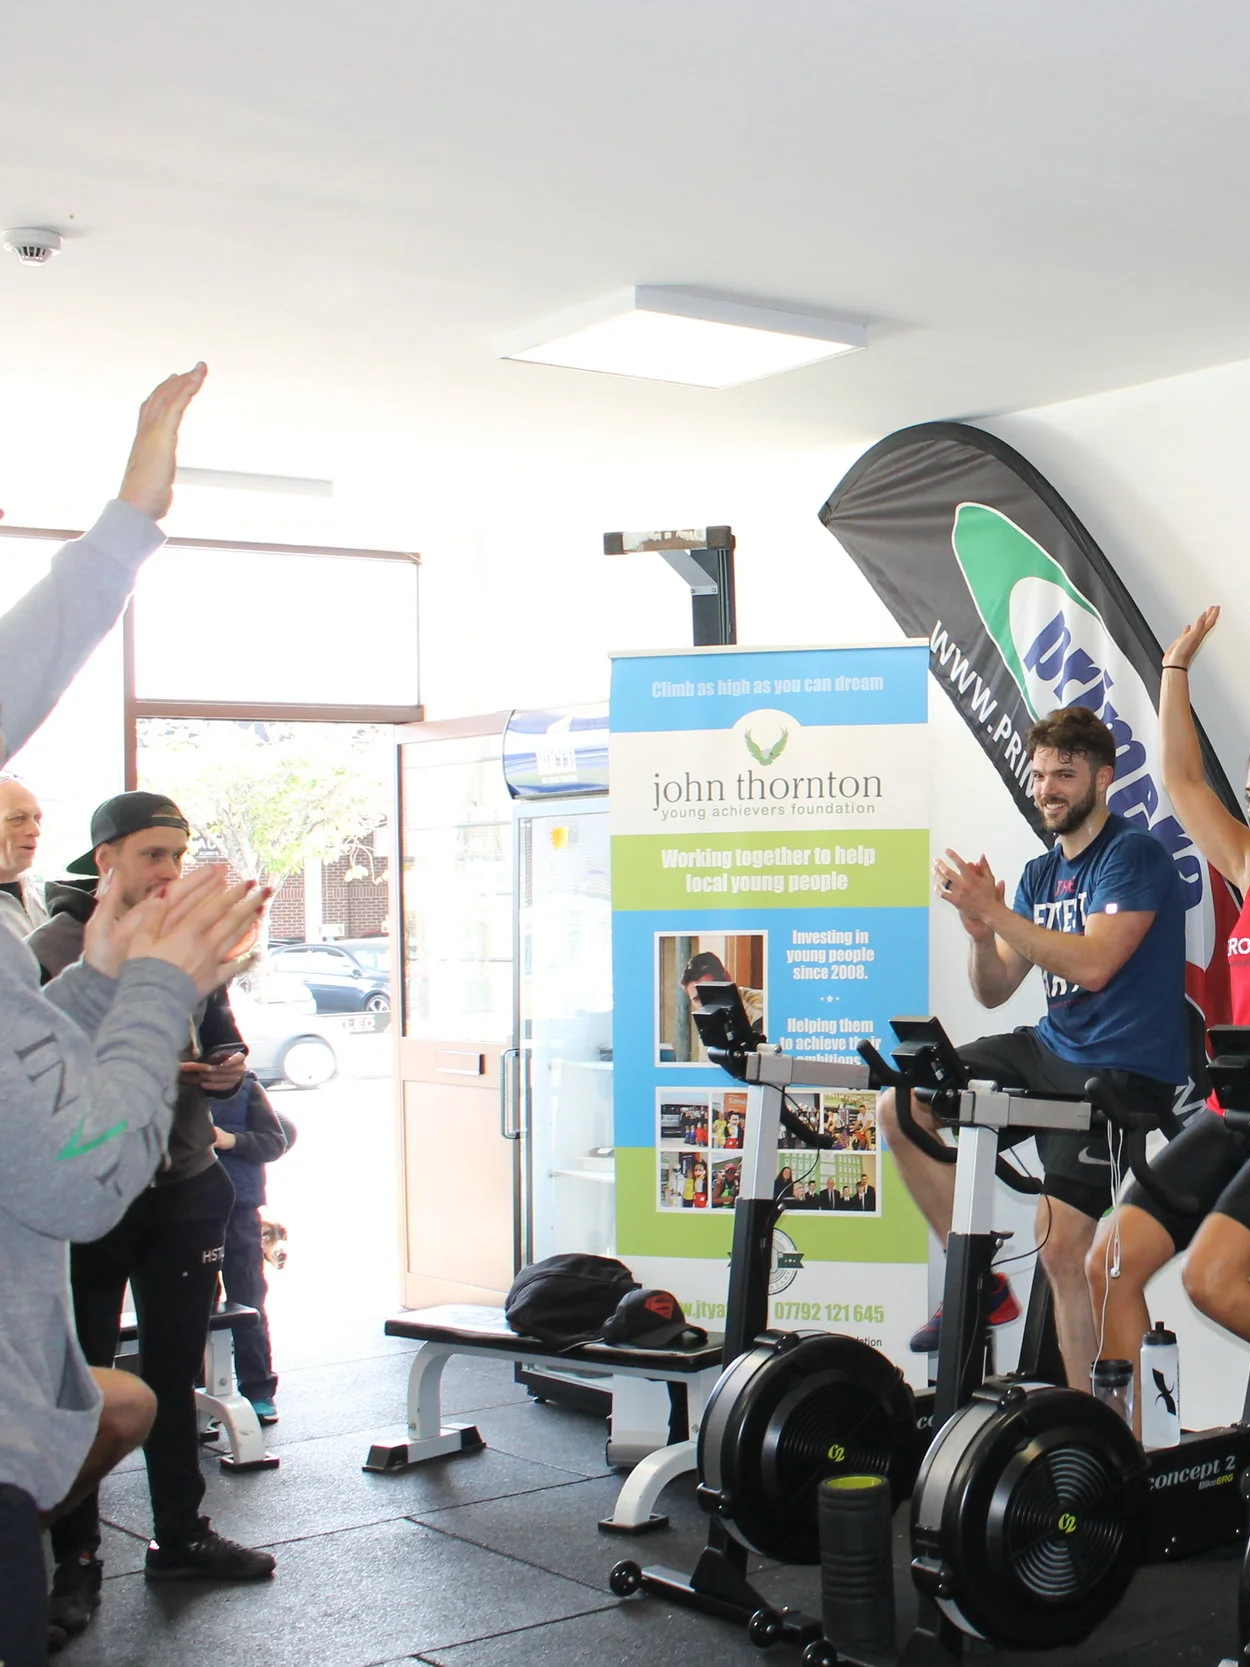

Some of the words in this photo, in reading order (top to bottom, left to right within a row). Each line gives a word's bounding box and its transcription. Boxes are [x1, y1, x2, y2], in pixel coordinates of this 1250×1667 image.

[652, 681, 694, 698] Climb
[697, 683, 714, 696] as
[717, 679, 750, 696] high
[753, 680, 770, 694] as
[774, 680, 801, 695] you
[804, 679, 831, 693] can
[834, 675, 883, 692] dream
[653, 772, 725, 811] john
[736, 769, 883, 801] thornton
[661, 805, 706, 821] young
[712, 804, 785, 817] achievers
[791, 802, 876, 815] foundation
[661, 848, 732, 870] Working
[735, 847, 810, 869] together
[814, 847, 831, 865] to
[835, 845, 876, 867] help
[686, 873, 728, 893] local
[731, 874, 784, 894] young
[788, 871, 848, 894] people
[792, 930, 853, 946] Investing
[855, 930, 869, 943] in
[786, 949, 826, 965] young
[828, 947, 875, 964] people
[793, 965, 828, 980] since
[831, 965, 868, 980] 2008.
[787, 1018, 837, 1035] Helping
[840, 1017, 874, 1033] them
[780, 1036, 793, 1051] to
[796, 1036, 846, 1051] achieve
[775, 1302, 821, 1321] 07792
[824, 1304, 850, 1321] 121
[853, 1305, 885, 1323] 645
[1226, 1456, 1236, 1470] 2
[1058, 1513, 1077, 1534] C2
